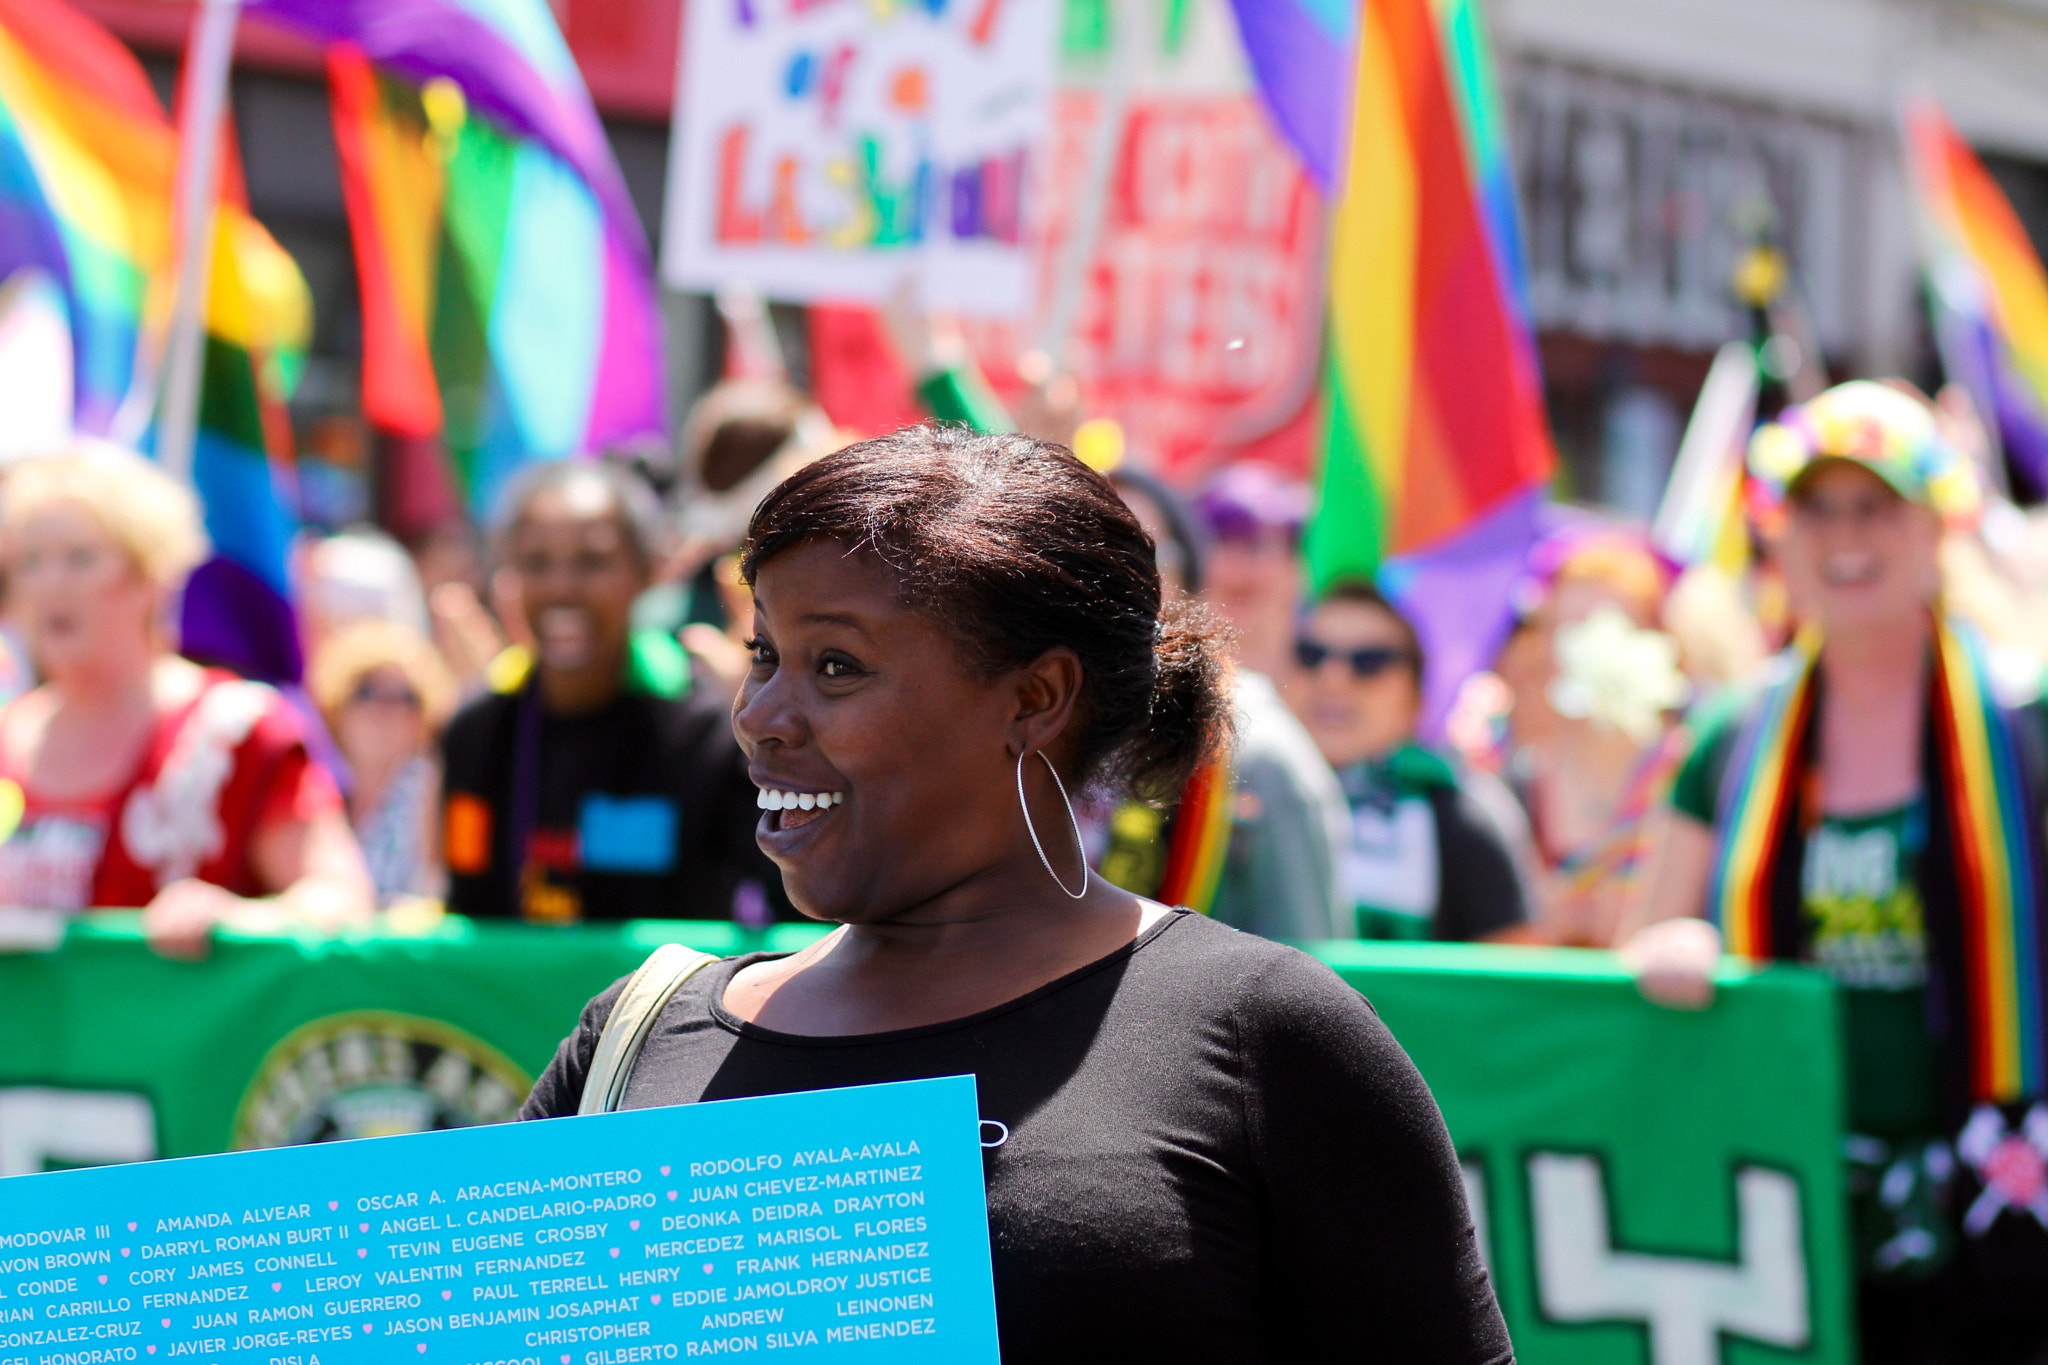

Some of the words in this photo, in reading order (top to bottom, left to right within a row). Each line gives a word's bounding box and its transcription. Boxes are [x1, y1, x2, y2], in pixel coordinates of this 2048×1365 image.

[44, 1249, 112, 1270] BROWN
[140, 1239, 211, 1260] DARRYL
[215, 1231, 282, 1252] ROMAN
[286, 1226, 333, 1245] BURT
[338, 1224, 349, 1239] II
[380, 1215, 441, 1235] ANGEL
[446, 1213, 461, 1229] L.
[466, 1192, 657, 1226] CANDELARIO-PADRO
[688, 1184, 739, 1204] JUAN
[743, 1164, 923, 1198] CHEVEZ-MARTINEZ
[95, 1224, 111, 1239] III
[155, 1211, 233, 1233] AMANDA
[242, 1203, 311, 1224] ALVEAR
[356, 1192, 419, 1212] OSCAR
[428, 1189, 448, 1205] A.
[455, 1168, 642, 1202] ARACENA-MONTERO
[690, 1153, 783, 1178] RODOLFO
[792, 1139, 921, 1167] AYALA-AYALA
[16, 1277, 79, 1297] CONDE
[128, 1267, 177, 1286] CORY
[187, 1260, 245, 1280] JAMES
[254, 1251, 338, 1273] CONNELL
[387, 1240, 441, 1259] TEVIN
[451, 1231, 525, 1253] EUGENE
[534, 1222, 609, 1245] CROSBY
[661, 1209, 741, 1232] DEONKA
[752, 1201, 823, 1223] DEIDRA
[834, 1190, 925, 1214] DRAYTON
[45, 1297, 131, 1319] CARRILLO
[142, 1285, 250, 1309] FERNANDEZ
[305, 1273, 363, 1293] LEROY
[374, 1263, 463, 1286] VALENTIN
[474, 1250, 586, 1276] FERNANDEZ
[644, 1234, 745, 1259] MERCEDEZ
[757, 1225, 842, 1248] MARISOL
[854, 1215, 928, 1238] FLORES
[191, 1311, 238, 1330] JUAN
[248, 1303, 314, 1324] RAMON
[324, 1293, 422, 1317] GUERRERO
[472, 1283, 520, 1302] PAUL
[528, 1274, 609, 1296] TERRELL
[619, 1266, 681, 1287] HENRY
[736, 1254, 801, 1276] FRANK
[811, 1241, 930, 1268] HERNANDEZ
[39, 1346, 137, 1365] HONORATO
[167, 1337, 227, 1357] JAVIER
[232, 1325, 353, 1351] JORGE-REYES
[384, 1316, 444, 1336] JASON
[448, 1306, 541, 1330] BENJAMIN
[545, 1296, 640, 1320] JOSAPHAT
[672, 1287, 728, 1308] EDDIE
[733, 1275, 849, 1302] JAMOLDROY
[855, 1267, 932, 1290] JUSTICE
[524, 1320, 651, 1347] CHRISTOPHER
[701, 1307, 785, 1330] ANDREW
[836, 1292, 934, 1317] LEINONEN
[584, 1343, 679, 1365] GILBERTO
[686, 1335, 758, 1357] RAMON
[765, 1329, 819, 1350] SILVA
[826, 1317, 936, 1344] MENENDEZ
